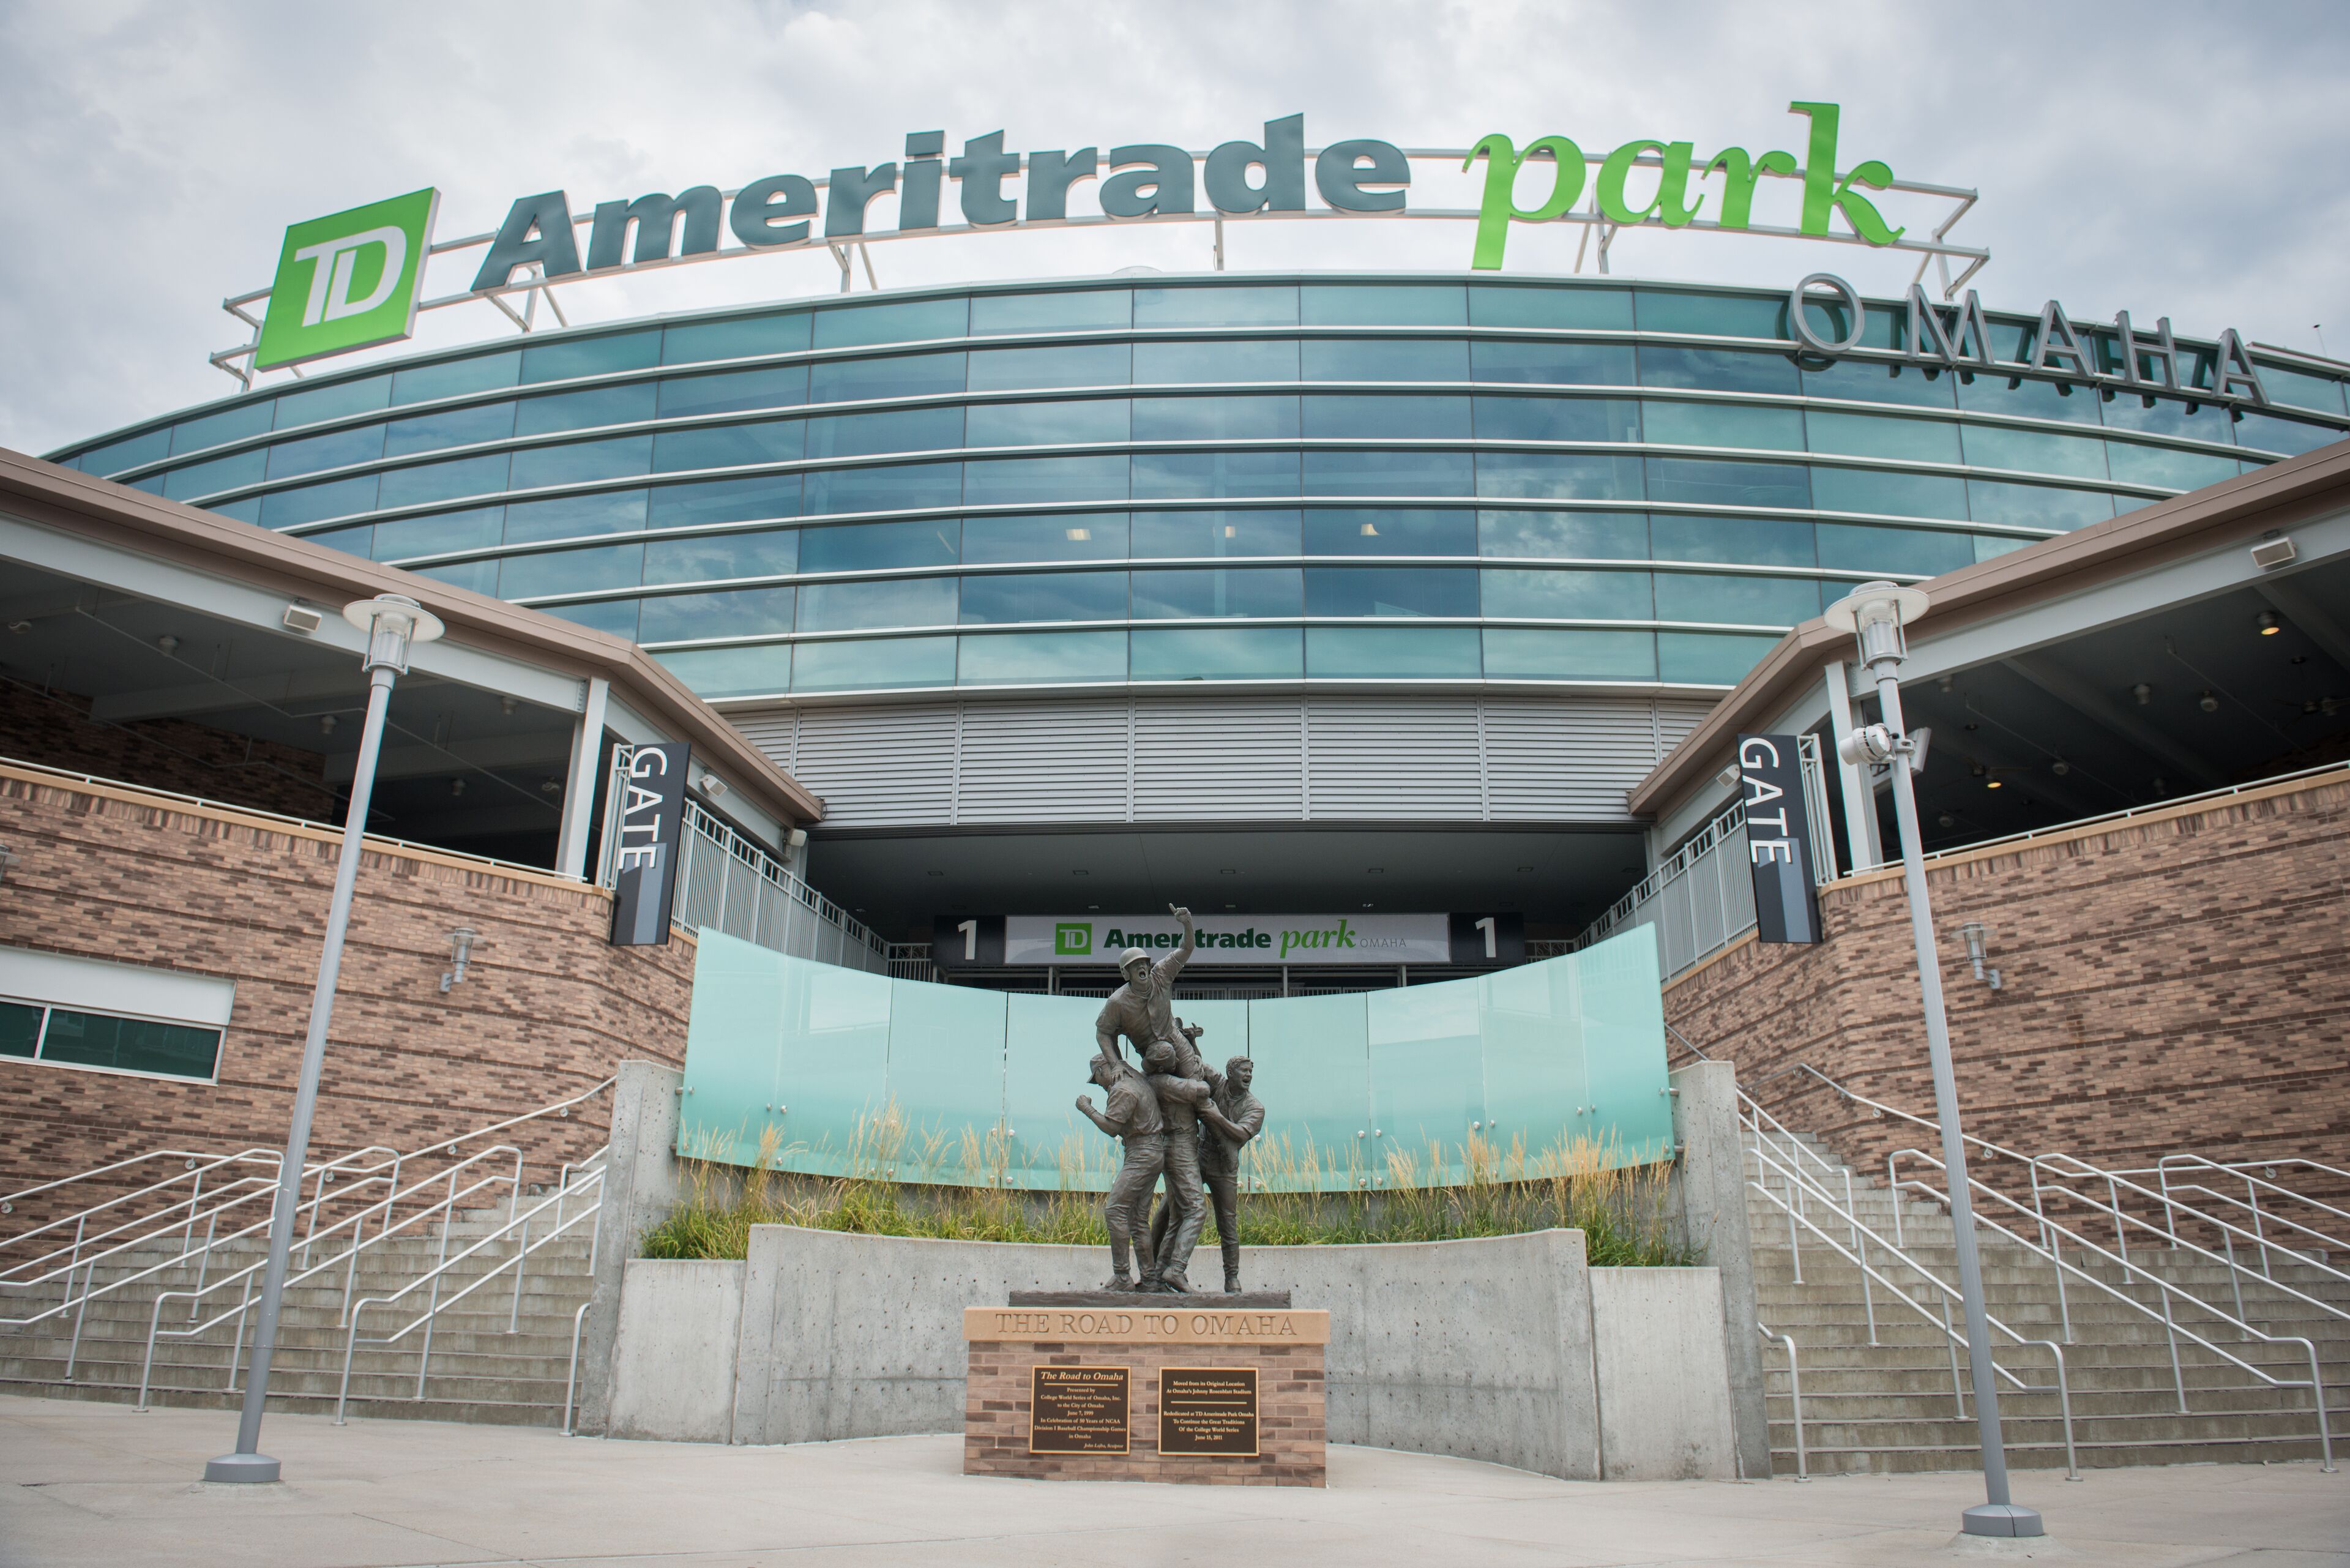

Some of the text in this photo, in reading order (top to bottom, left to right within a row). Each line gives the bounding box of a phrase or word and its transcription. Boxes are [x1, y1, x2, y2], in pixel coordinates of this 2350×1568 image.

[294, 101, 1906, 327] TD Ameritrade park
[1789, 272, 2270, 408] OMAHA
[619, 747, 668, 870] GATE
[1739, 737, 1791, 863] GATE
[958, 920, 977, 960] 1
[1059, 919, 1406, 958] TD Amertrade park OMAHA
[1475, 917, 1496, 958] 1
[996, 1313, 1297, 1335] THE ROAD TO OMAHA
